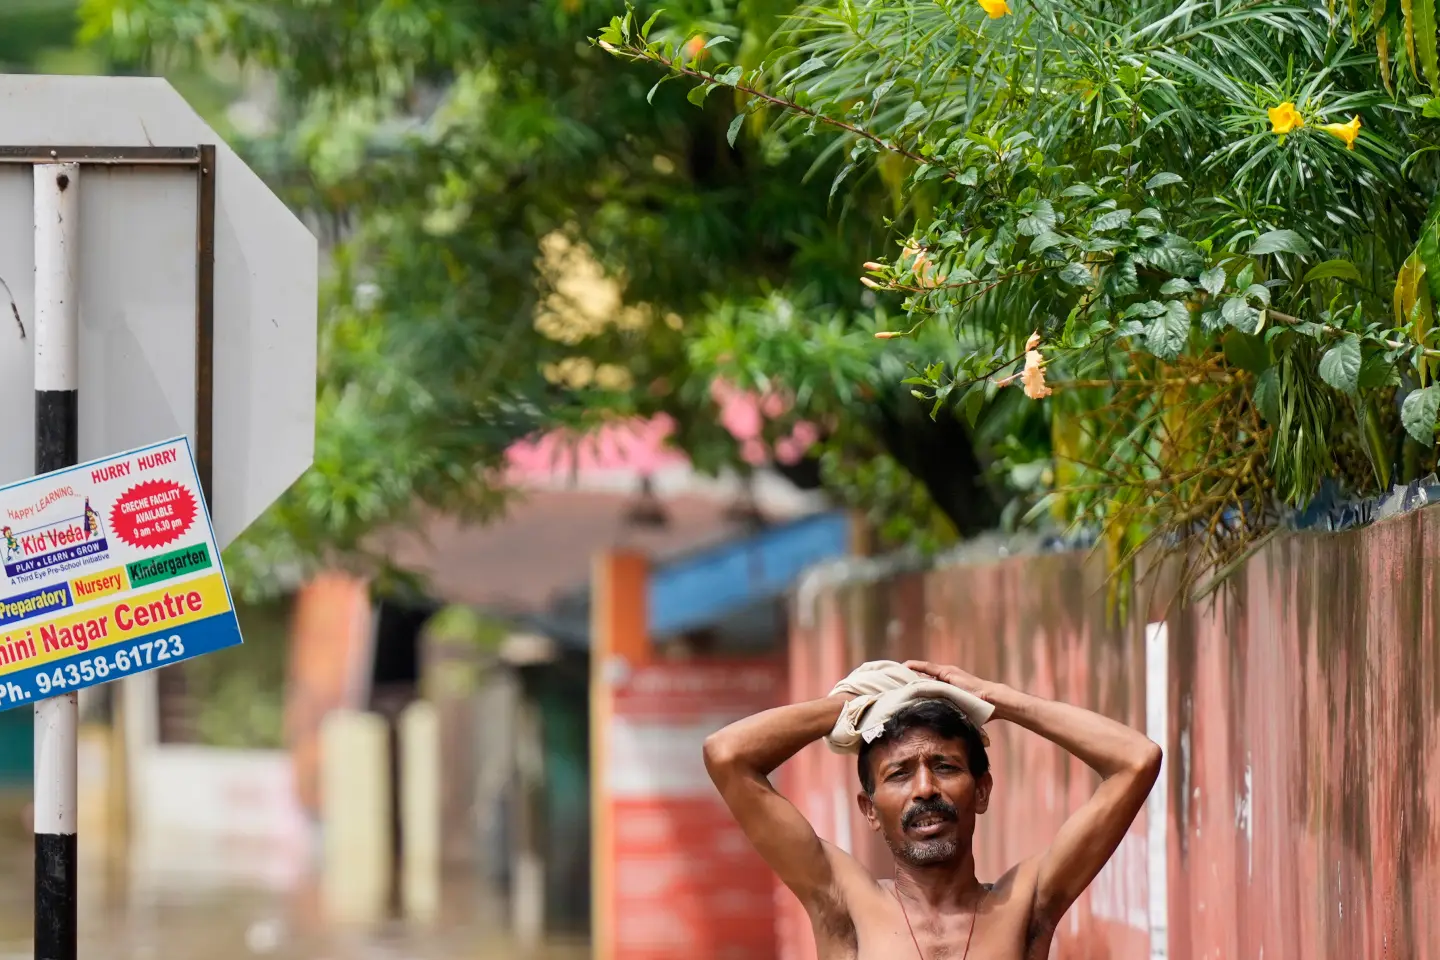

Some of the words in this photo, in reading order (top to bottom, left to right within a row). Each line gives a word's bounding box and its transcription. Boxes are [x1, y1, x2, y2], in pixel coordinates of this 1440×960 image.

[91, 461, 131, 484] HURRY
[137, 448, 177, 471] HURRY
[7, 505, 34, 520] HAPPY
[120, 498, 150, 514] CRECHE
[150, 488, 180, 506] FACILITY
[135, 505, 174, 524] AVAILABLE
[21, 532, 46, 556] Kid
[47, 524, 83, 548] Veda
[133, 528, 139, 538] 9
[140, 526, 151, 536] am
[155, 519, 170, 532] 6.30
[171, 518, 182, 530] pm
[16, 560, 35, 573] PLAY
[42, 551, 68, 565] LEARN
[76, 542, 100, 556] GROW
[16, 572, 33, 584] Third
[34, 571, 46, 580] Eye
[47, 559, 82, 576] Pre-School
[82, 553, 110, 566] Initiative
[130, 550, 206, 581] Kindergarten
[74, 572, 122, 597] Nursery
[40, 616, 108, 651] Nagar
[114, 591, 202, 631] Centre
[35, 635, 185, 694] 94358-61723
